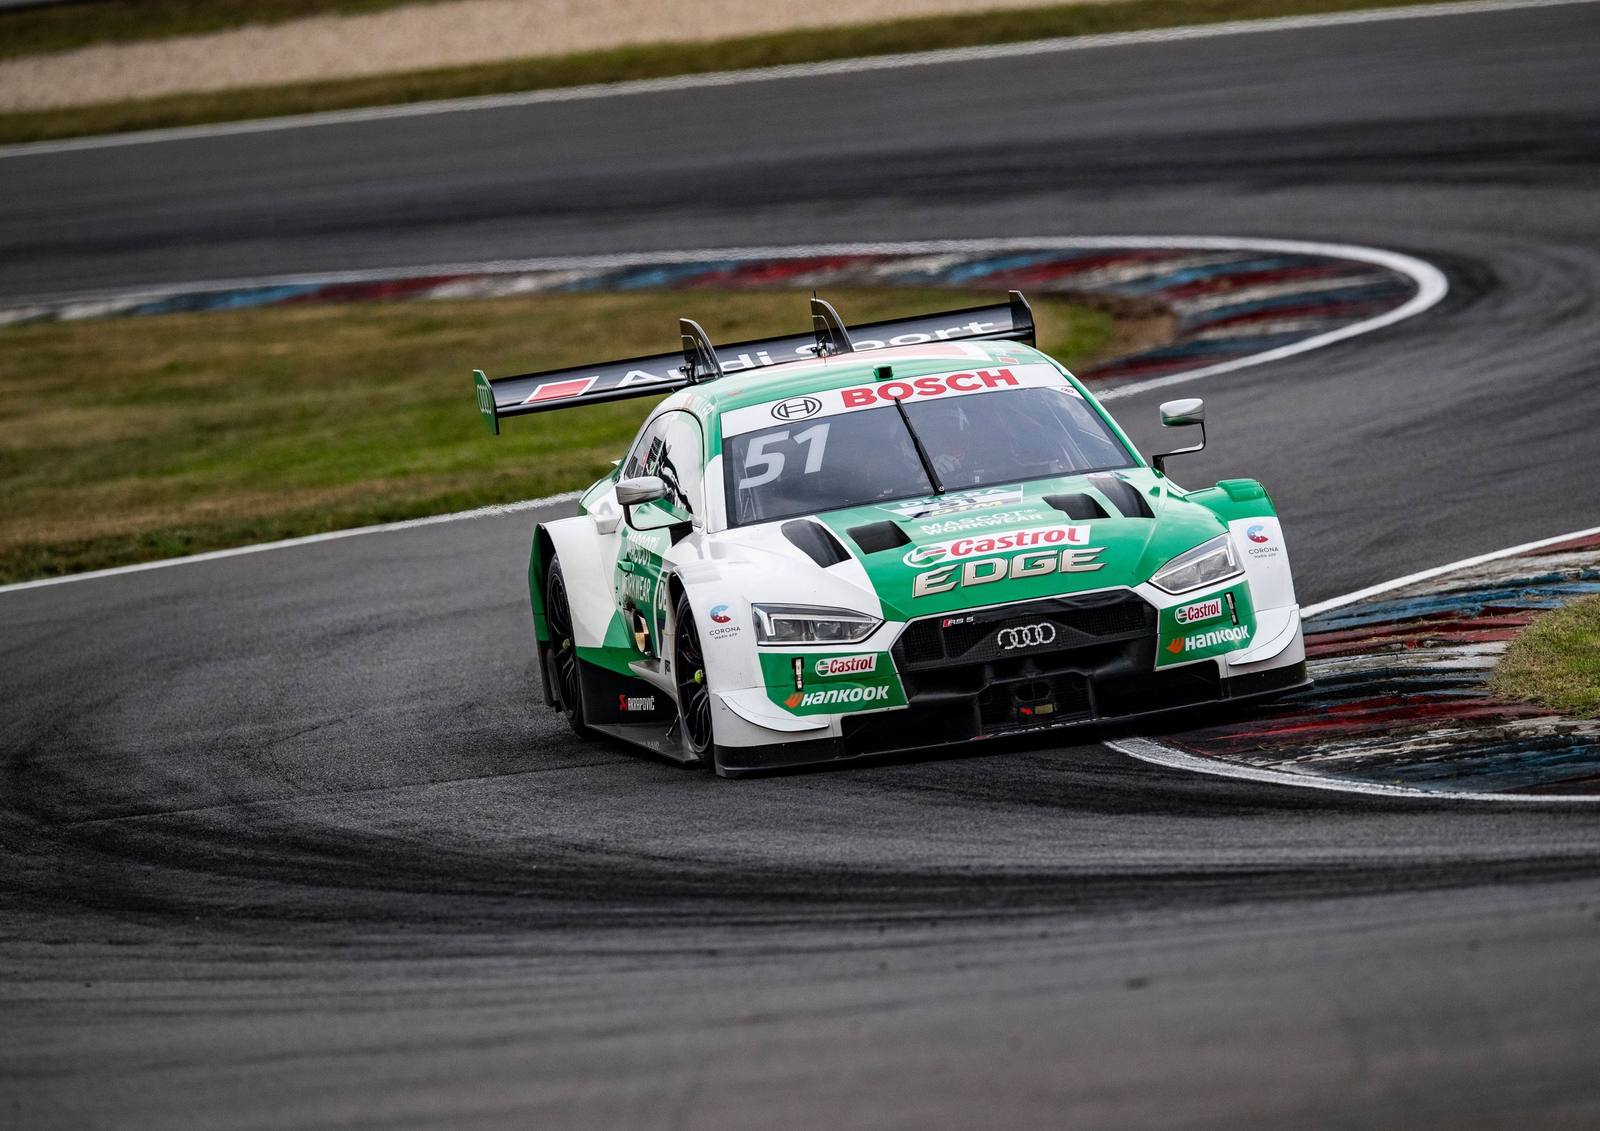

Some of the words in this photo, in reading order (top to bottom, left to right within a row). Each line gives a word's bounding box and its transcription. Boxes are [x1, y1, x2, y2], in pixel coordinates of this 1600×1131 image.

[840, 368, 1020, 409] BOSCH
[738, 423, 831, 490] 51
[950, 527, 1081, 557] Castrol
[1248, 546, 1279, 555] CORONA
[911, 546, 1108, 599] EDGE
[1187, 601, 1221, 621] Castrol
[709, 626, 741, 636] CORONA
[829, 655, 873, 675] Castrol
